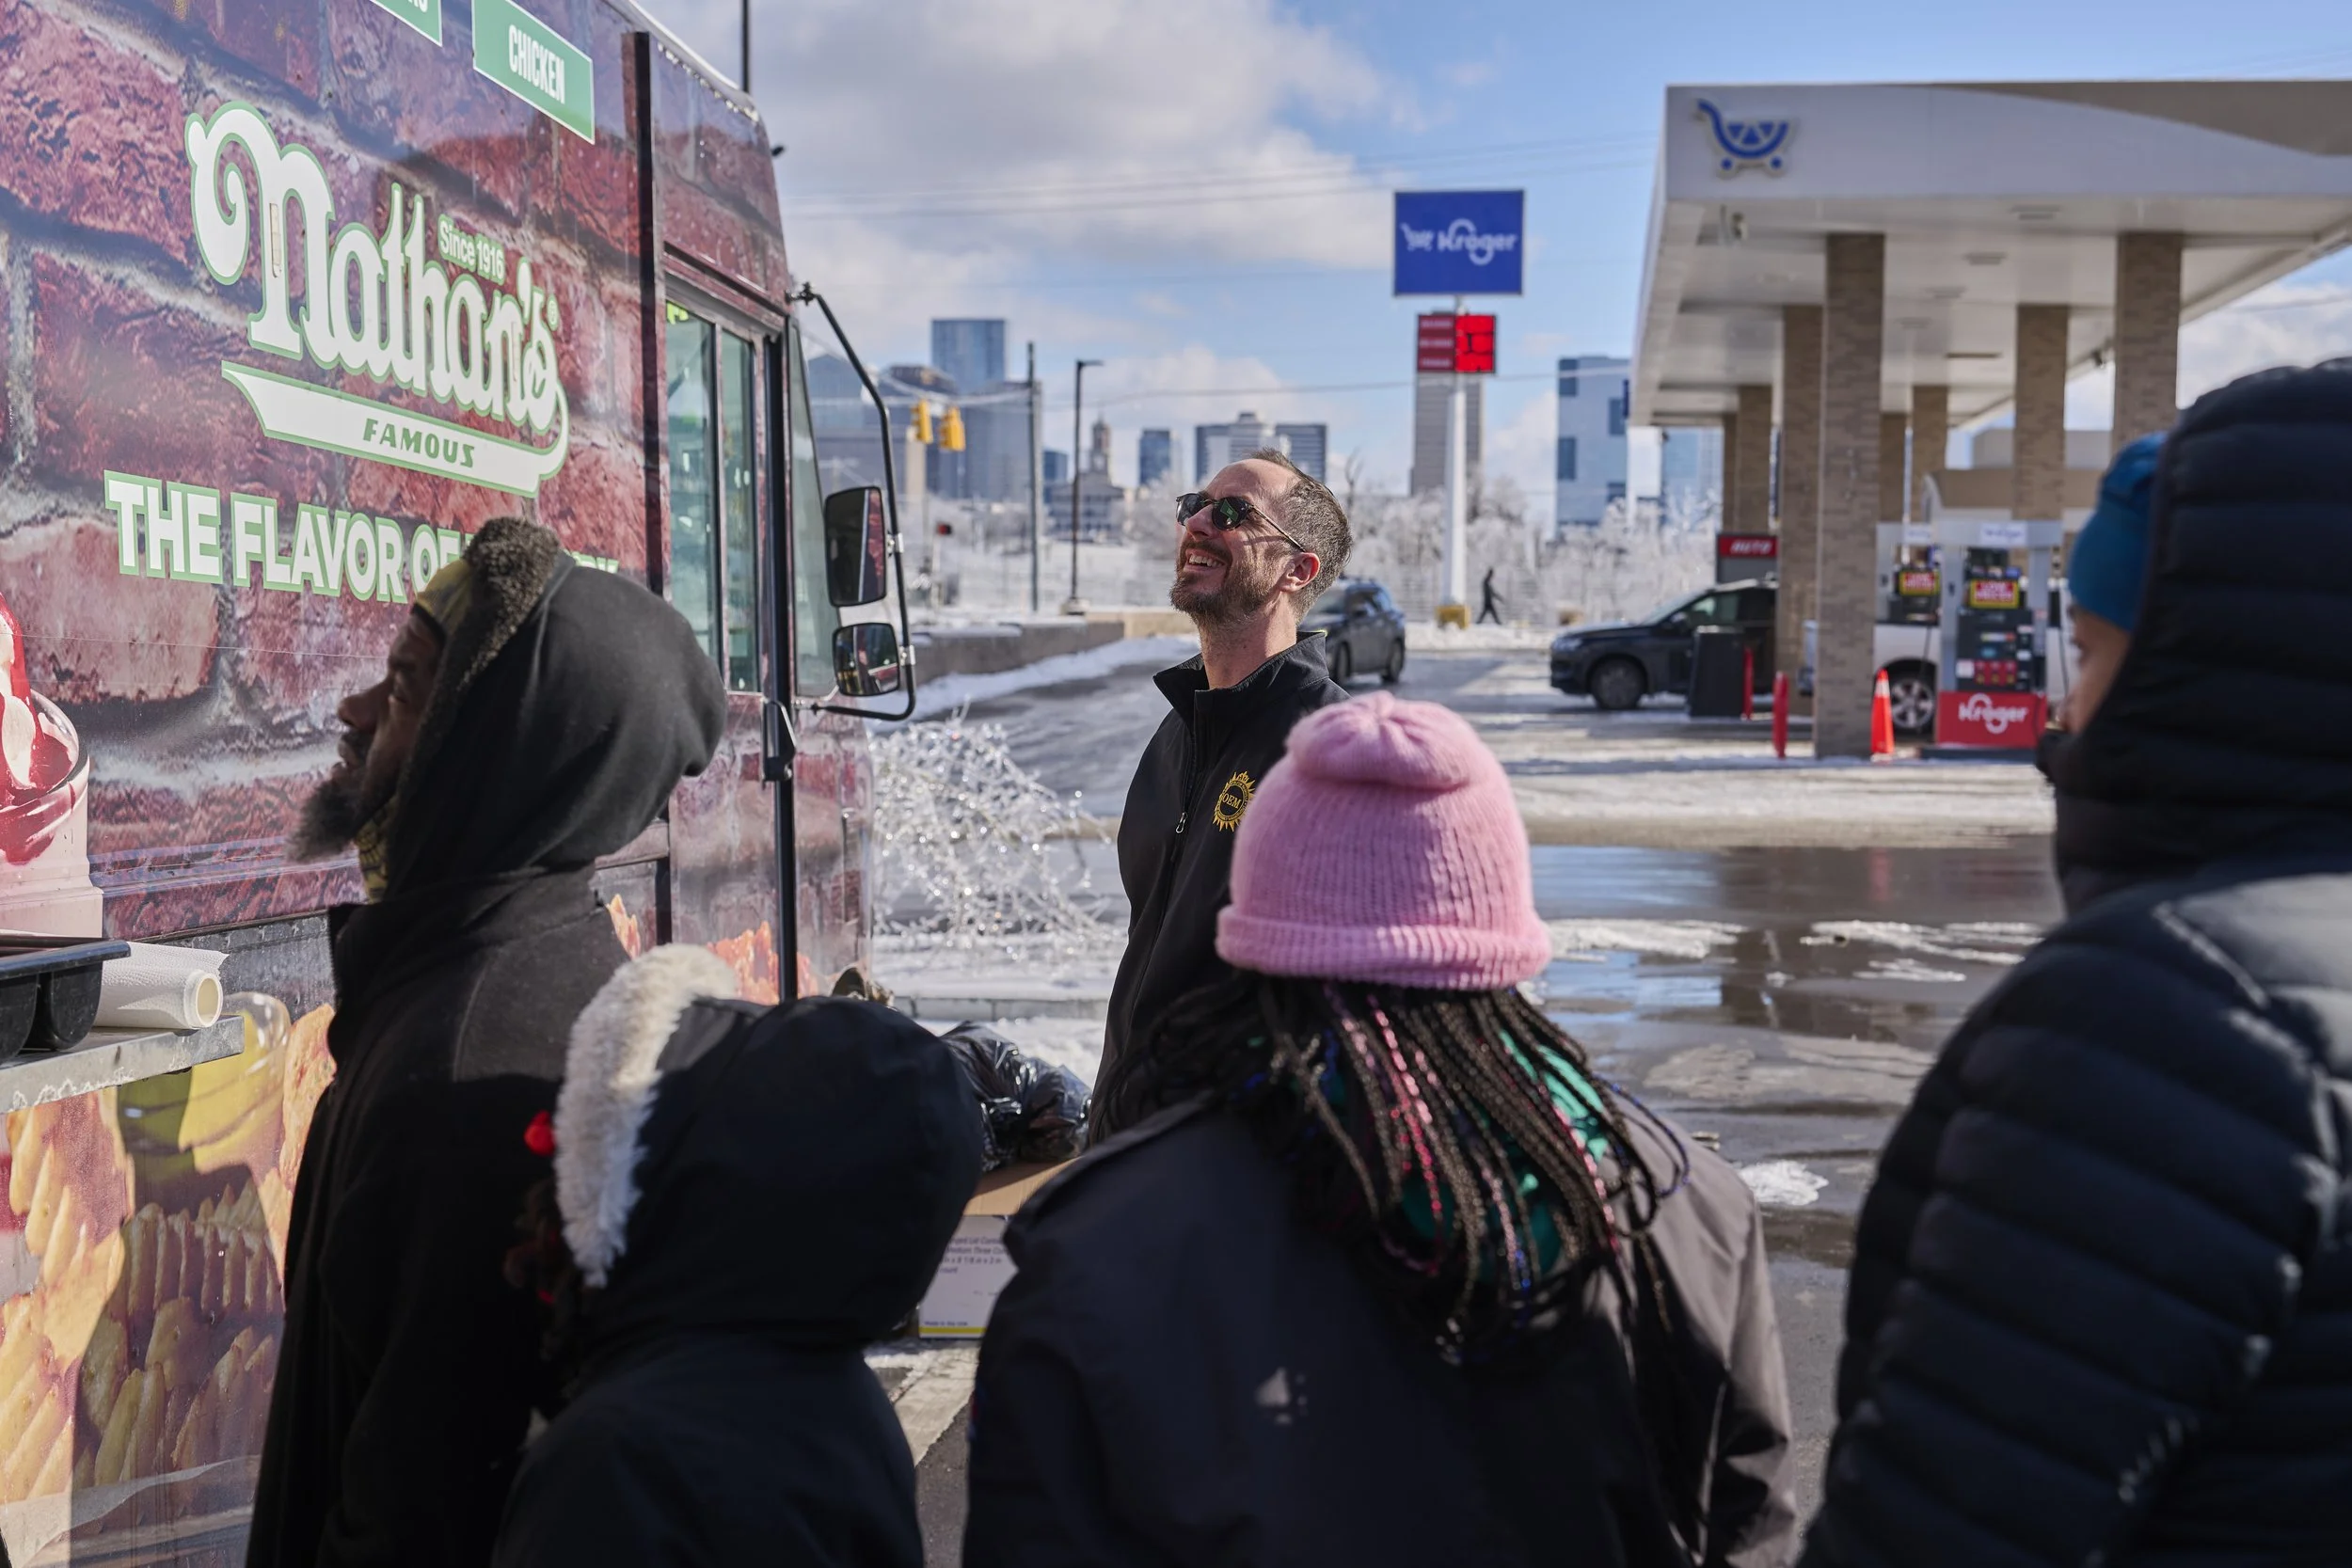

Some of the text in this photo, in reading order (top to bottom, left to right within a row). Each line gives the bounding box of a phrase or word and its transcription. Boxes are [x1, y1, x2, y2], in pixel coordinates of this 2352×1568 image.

[508, 24, 565, 104] CHICKEN
[185, 102, 557, 436] Nathan's
[438, 217, 505, 284] Since 1916
[1438, 217, 1517, 265] Kroger
[363, 418, 476, 468] FAMOUS
[105, 471, 223, 584] THE
[230, 493, 407, 604] FLAVOR
[1958, 692, 2027, 734] Kroger
[1223, 793, 1242, 809] OEM
